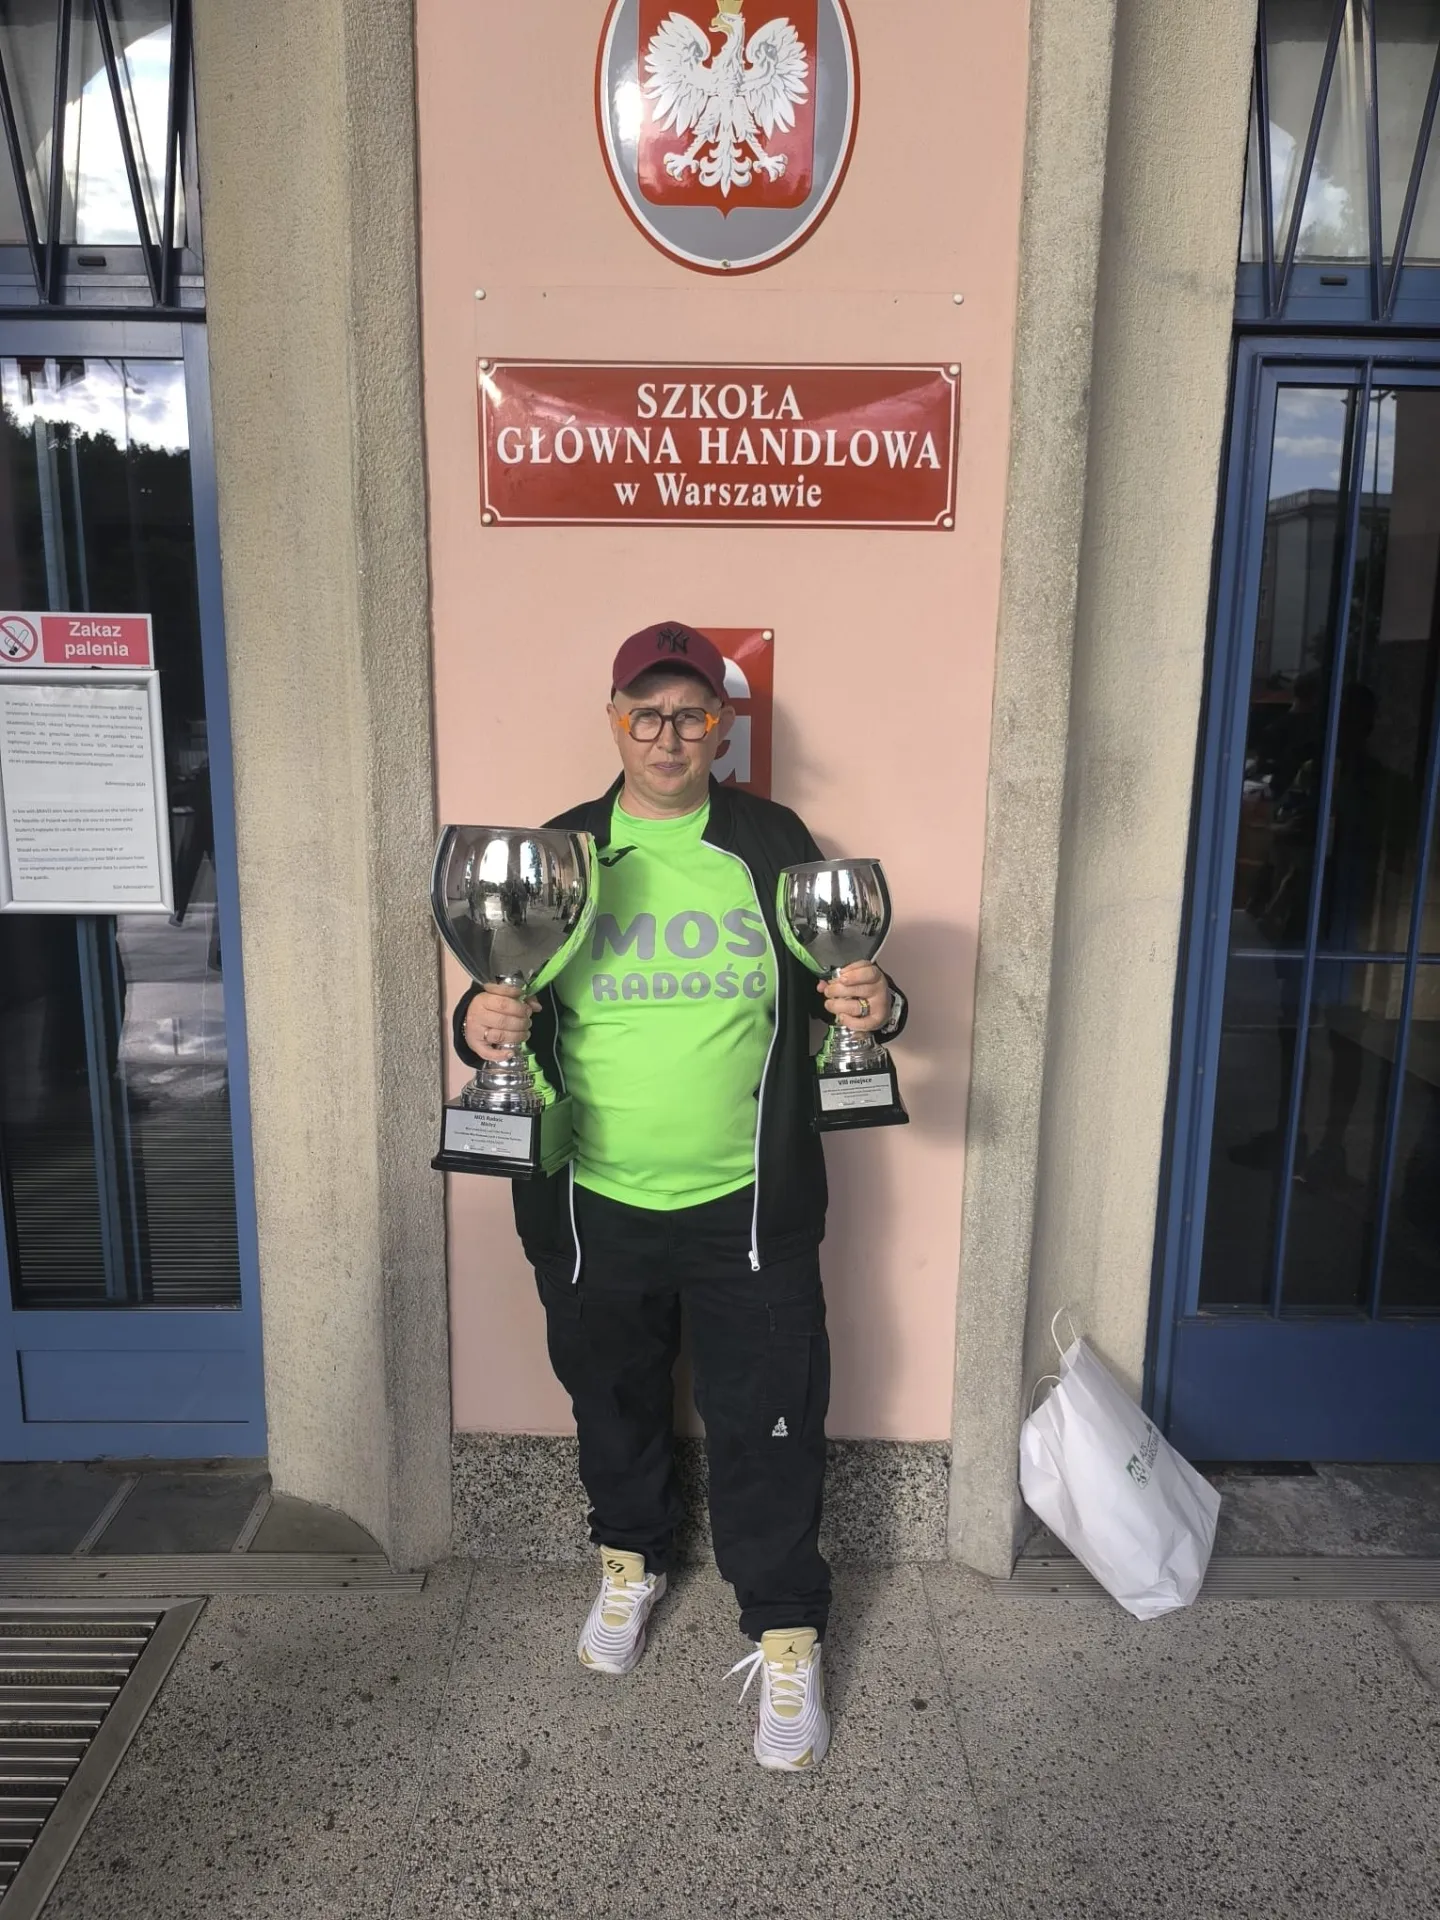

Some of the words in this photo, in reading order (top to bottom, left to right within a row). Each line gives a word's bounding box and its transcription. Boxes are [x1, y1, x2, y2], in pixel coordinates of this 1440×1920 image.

[637, 382, 804, 421] SZKOŁA
[496, 414, 682, 466] GŁÓWNA
[698, 426, 942, 470] HANDLOWA
[614, 482, 640, 506] w
[654, 472, 823, 508] Warszawie
[68, 621, 122, 638] Zakaz
[64, 640, 129, 660] palenia
[591, 908, 768, 961] MOS
[591, 963, 768, 1002] RADOŚĆ
[849, 1077, 873, 1085] miejsce
